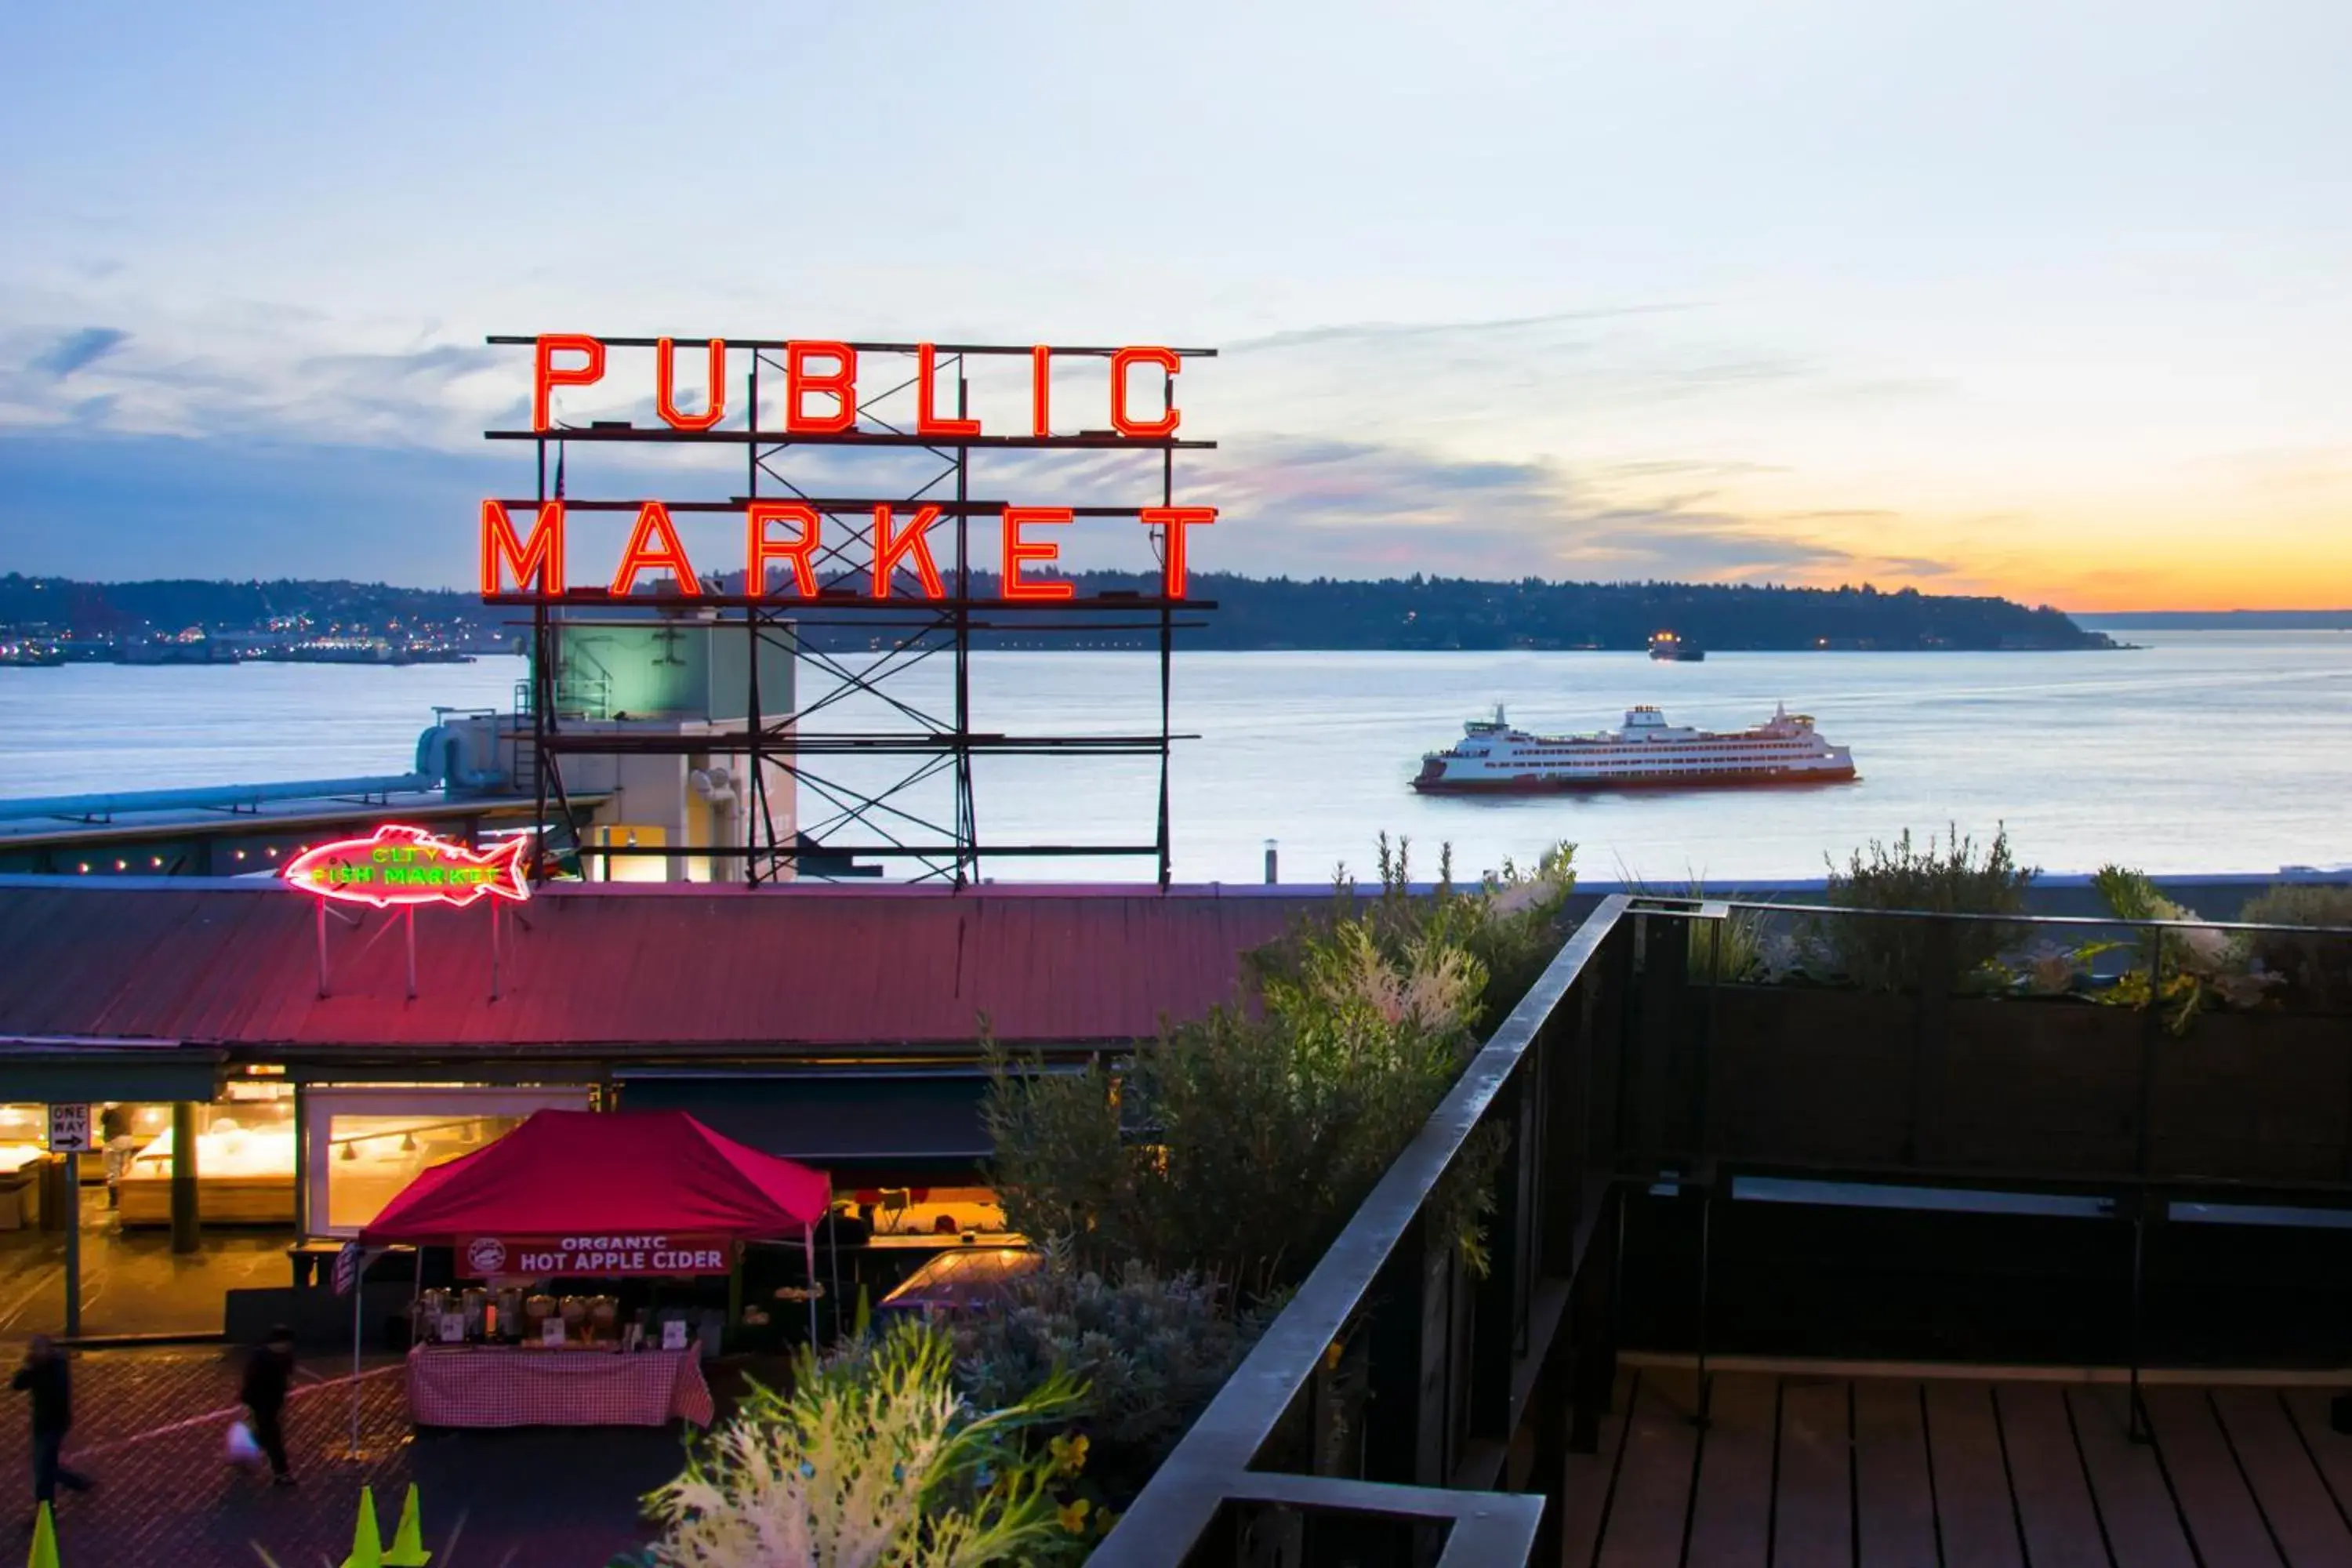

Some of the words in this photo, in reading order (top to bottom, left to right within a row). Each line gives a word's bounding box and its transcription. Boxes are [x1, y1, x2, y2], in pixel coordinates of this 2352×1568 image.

[533, 333, 1181, 437] PUBLIC
[481, 498, 1217, 601] MARKET
[372, 847, 441, 863] CITY
[311, 866, 373, 884] FISH
[383, 866, 500, 886] MARKET
[54, 1106, 85, 1119] ONE
[54, 1120, 86, 1133] WAY
[561, 1236, 668, 1250] ORGANIC
[521, 1254, 568, 1272] HOT
[575, 1253, 645, 1270] APPLE
[652, 1251, 723, 1269] CIDER
